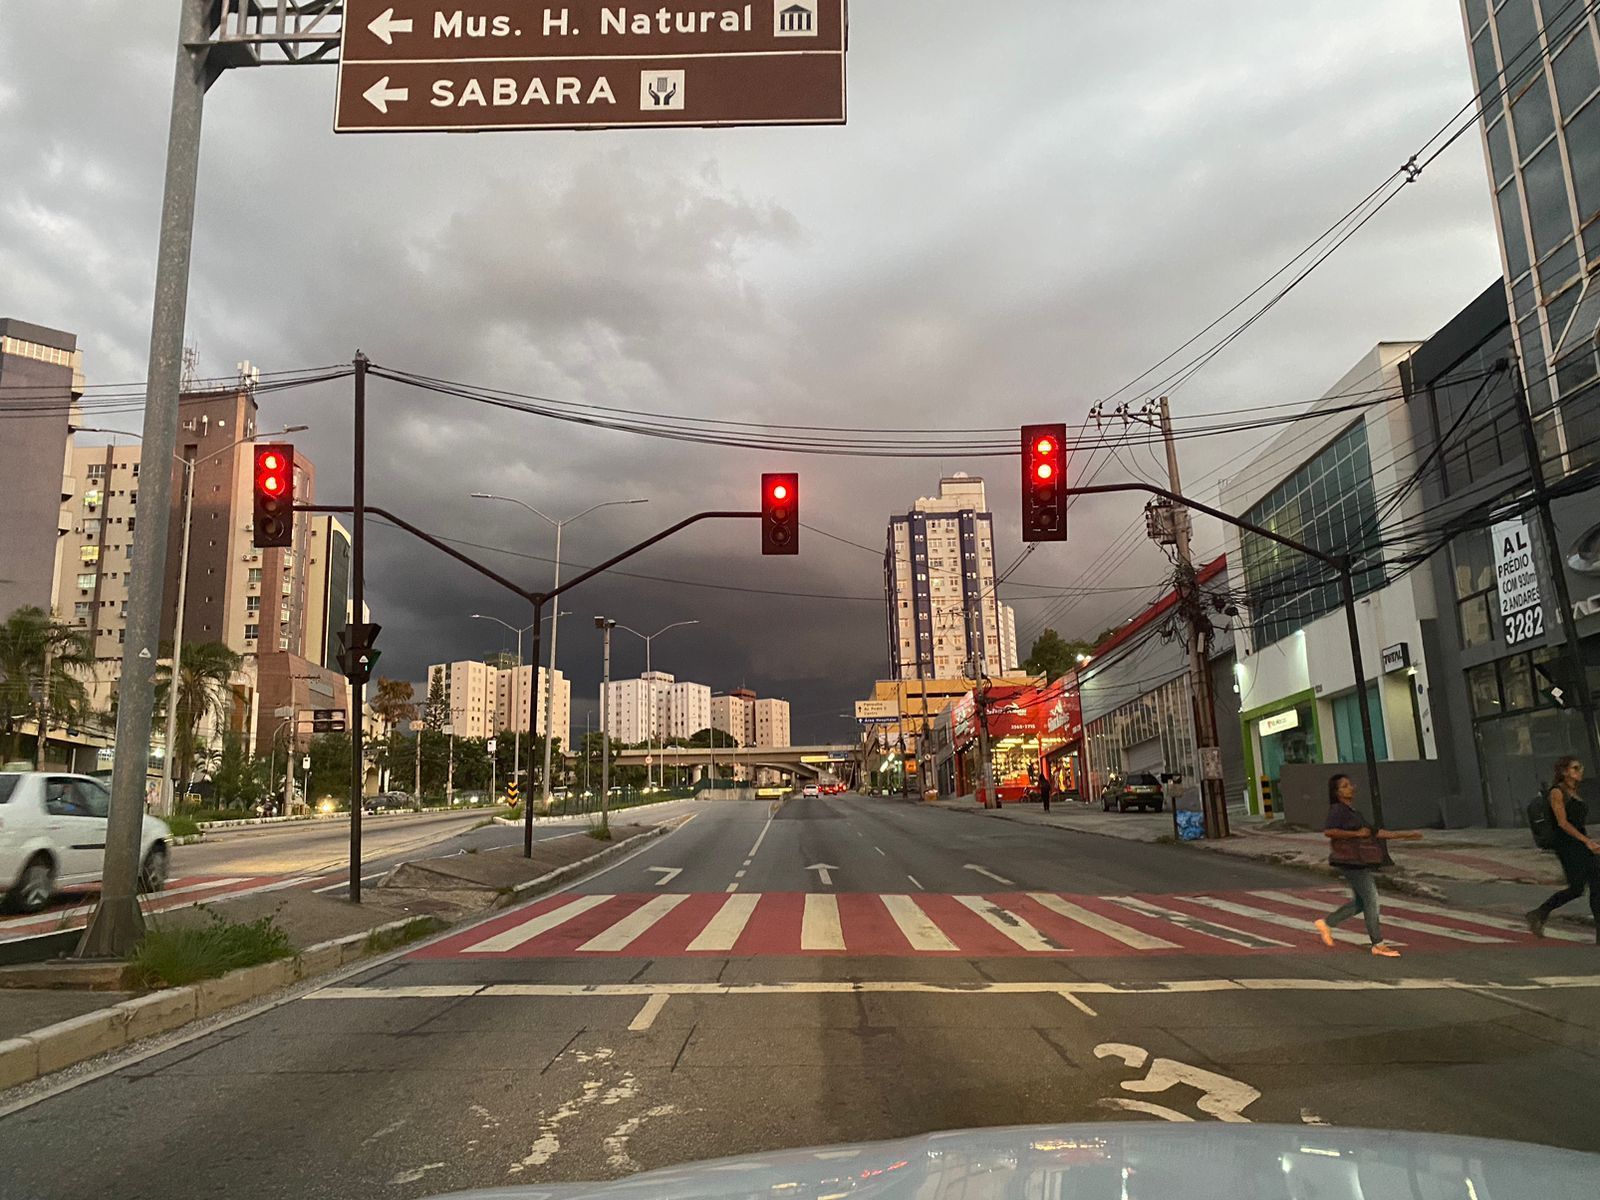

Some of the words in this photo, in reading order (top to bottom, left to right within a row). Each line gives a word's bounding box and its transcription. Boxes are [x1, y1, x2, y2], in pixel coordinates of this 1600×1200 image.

[433, 8, 521, 38] Mus.
[542, 8, 579, 36] H.
[600, 4, 752, 35] Natural
[430, 76, 617, 107] SABARA
[1497, 553, 1529, 578] PRÉDIO
[1502, 577, 1518, 594] COM
[1503, 599, 1509, 612] 2
[1505, 606, 1543, 644] 3282
